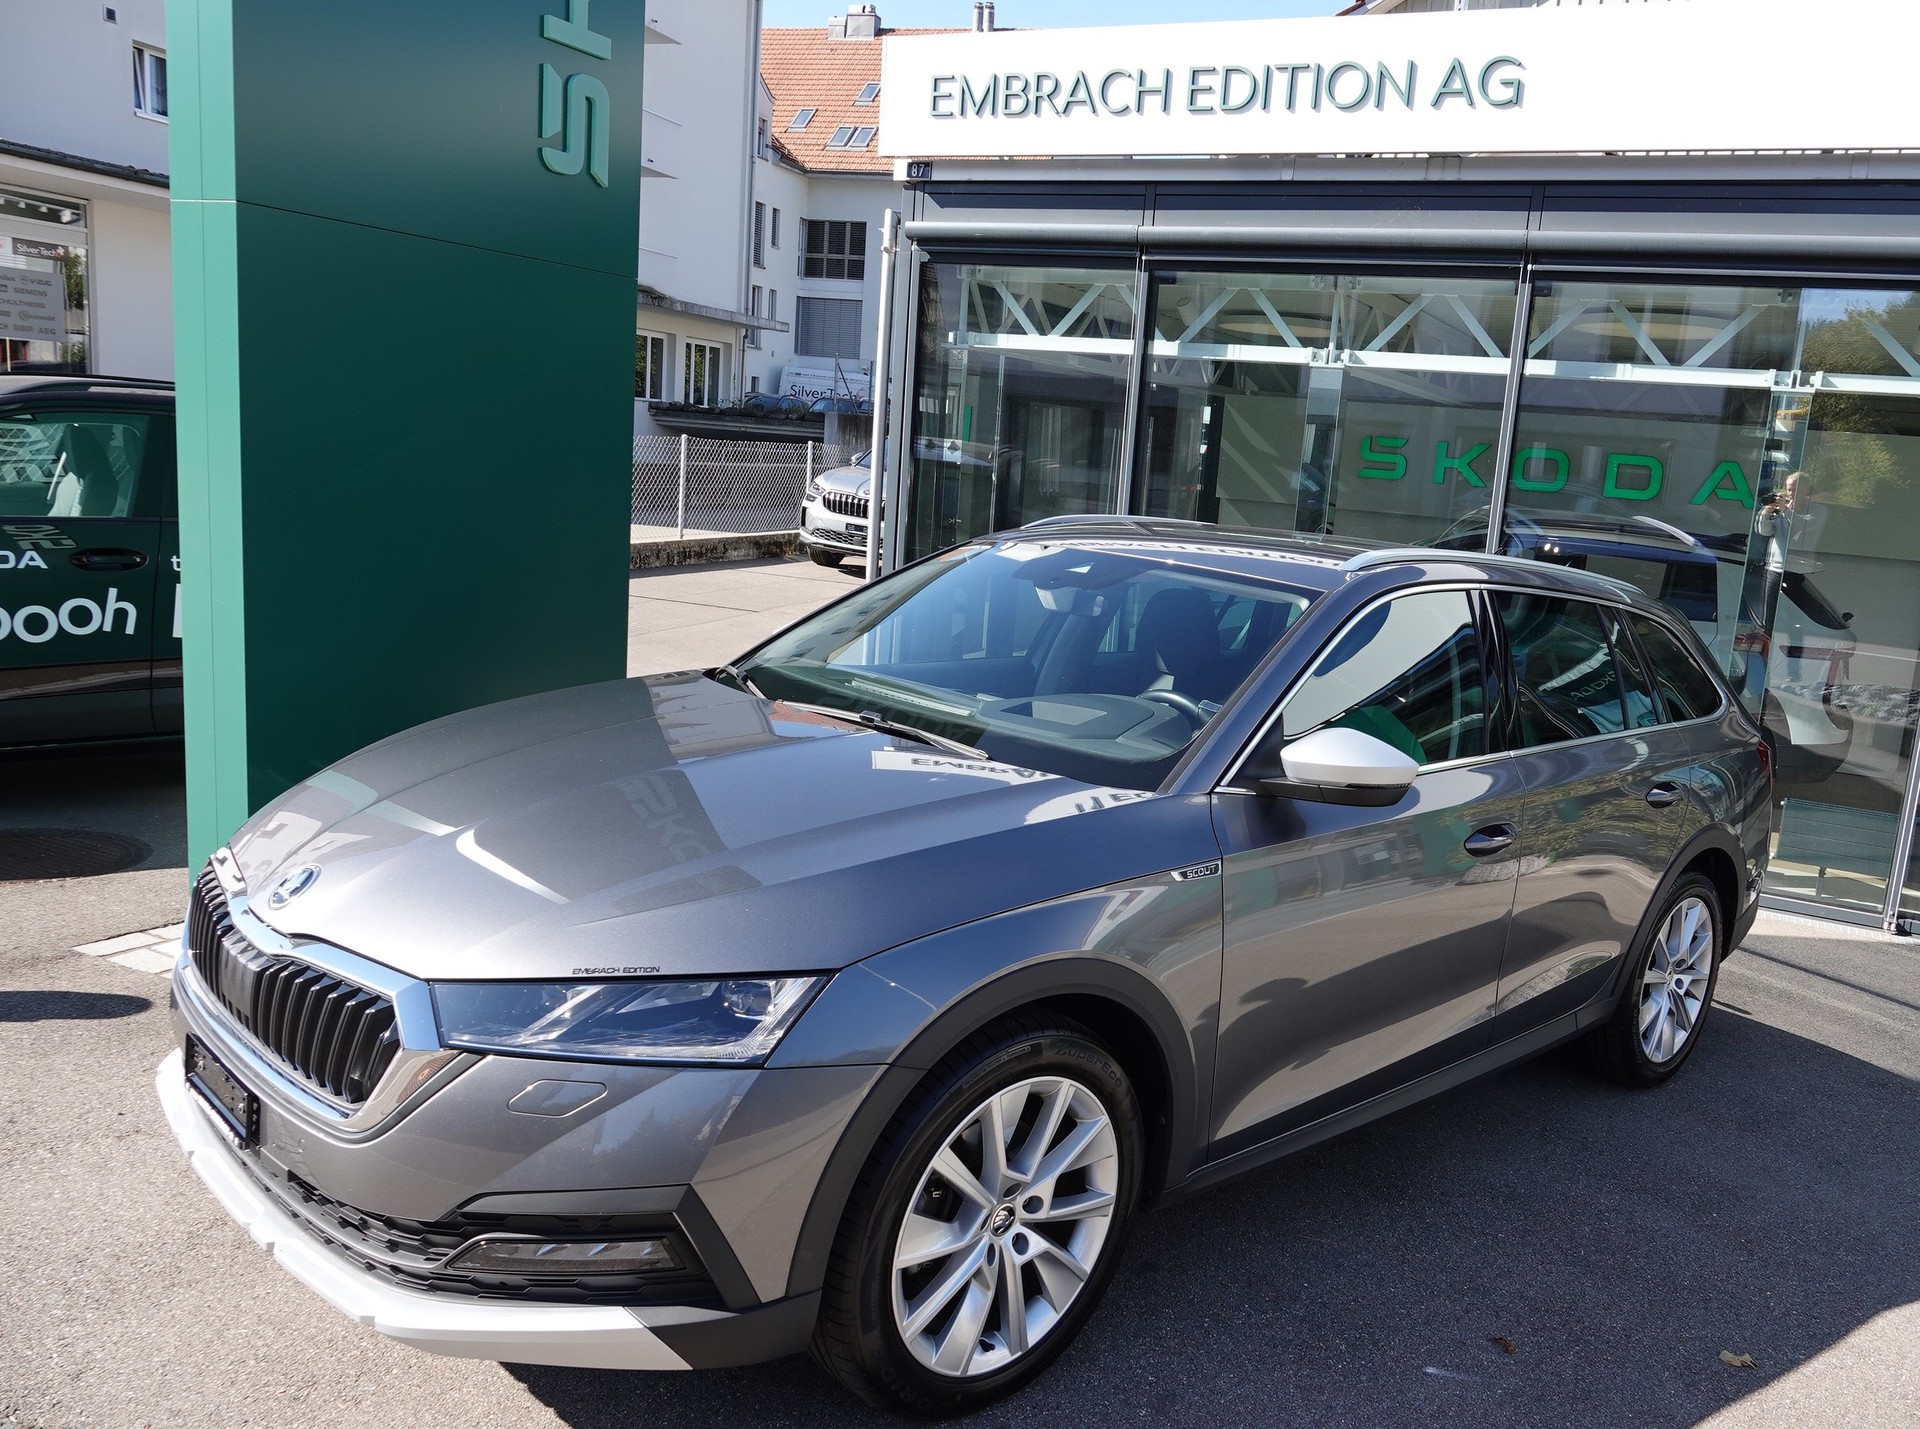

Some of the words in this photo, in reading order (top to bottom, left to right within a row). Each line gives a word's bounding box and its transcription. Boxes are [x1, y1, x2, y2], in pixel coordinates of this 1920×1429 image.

[929, 68, 1173, 118] EMBRACH
[1187, 58, 1414, 113] EDITION
[1430, 54, 1527, 107] AG
[911, 163, 925, 177] 87
[38, 327, 57, 335] AEG
[1186, 864, 1217, 879] SCOUT
[572, 967, 620, 975] EMBRACH
[622, 966, 660, 974] EDITION
